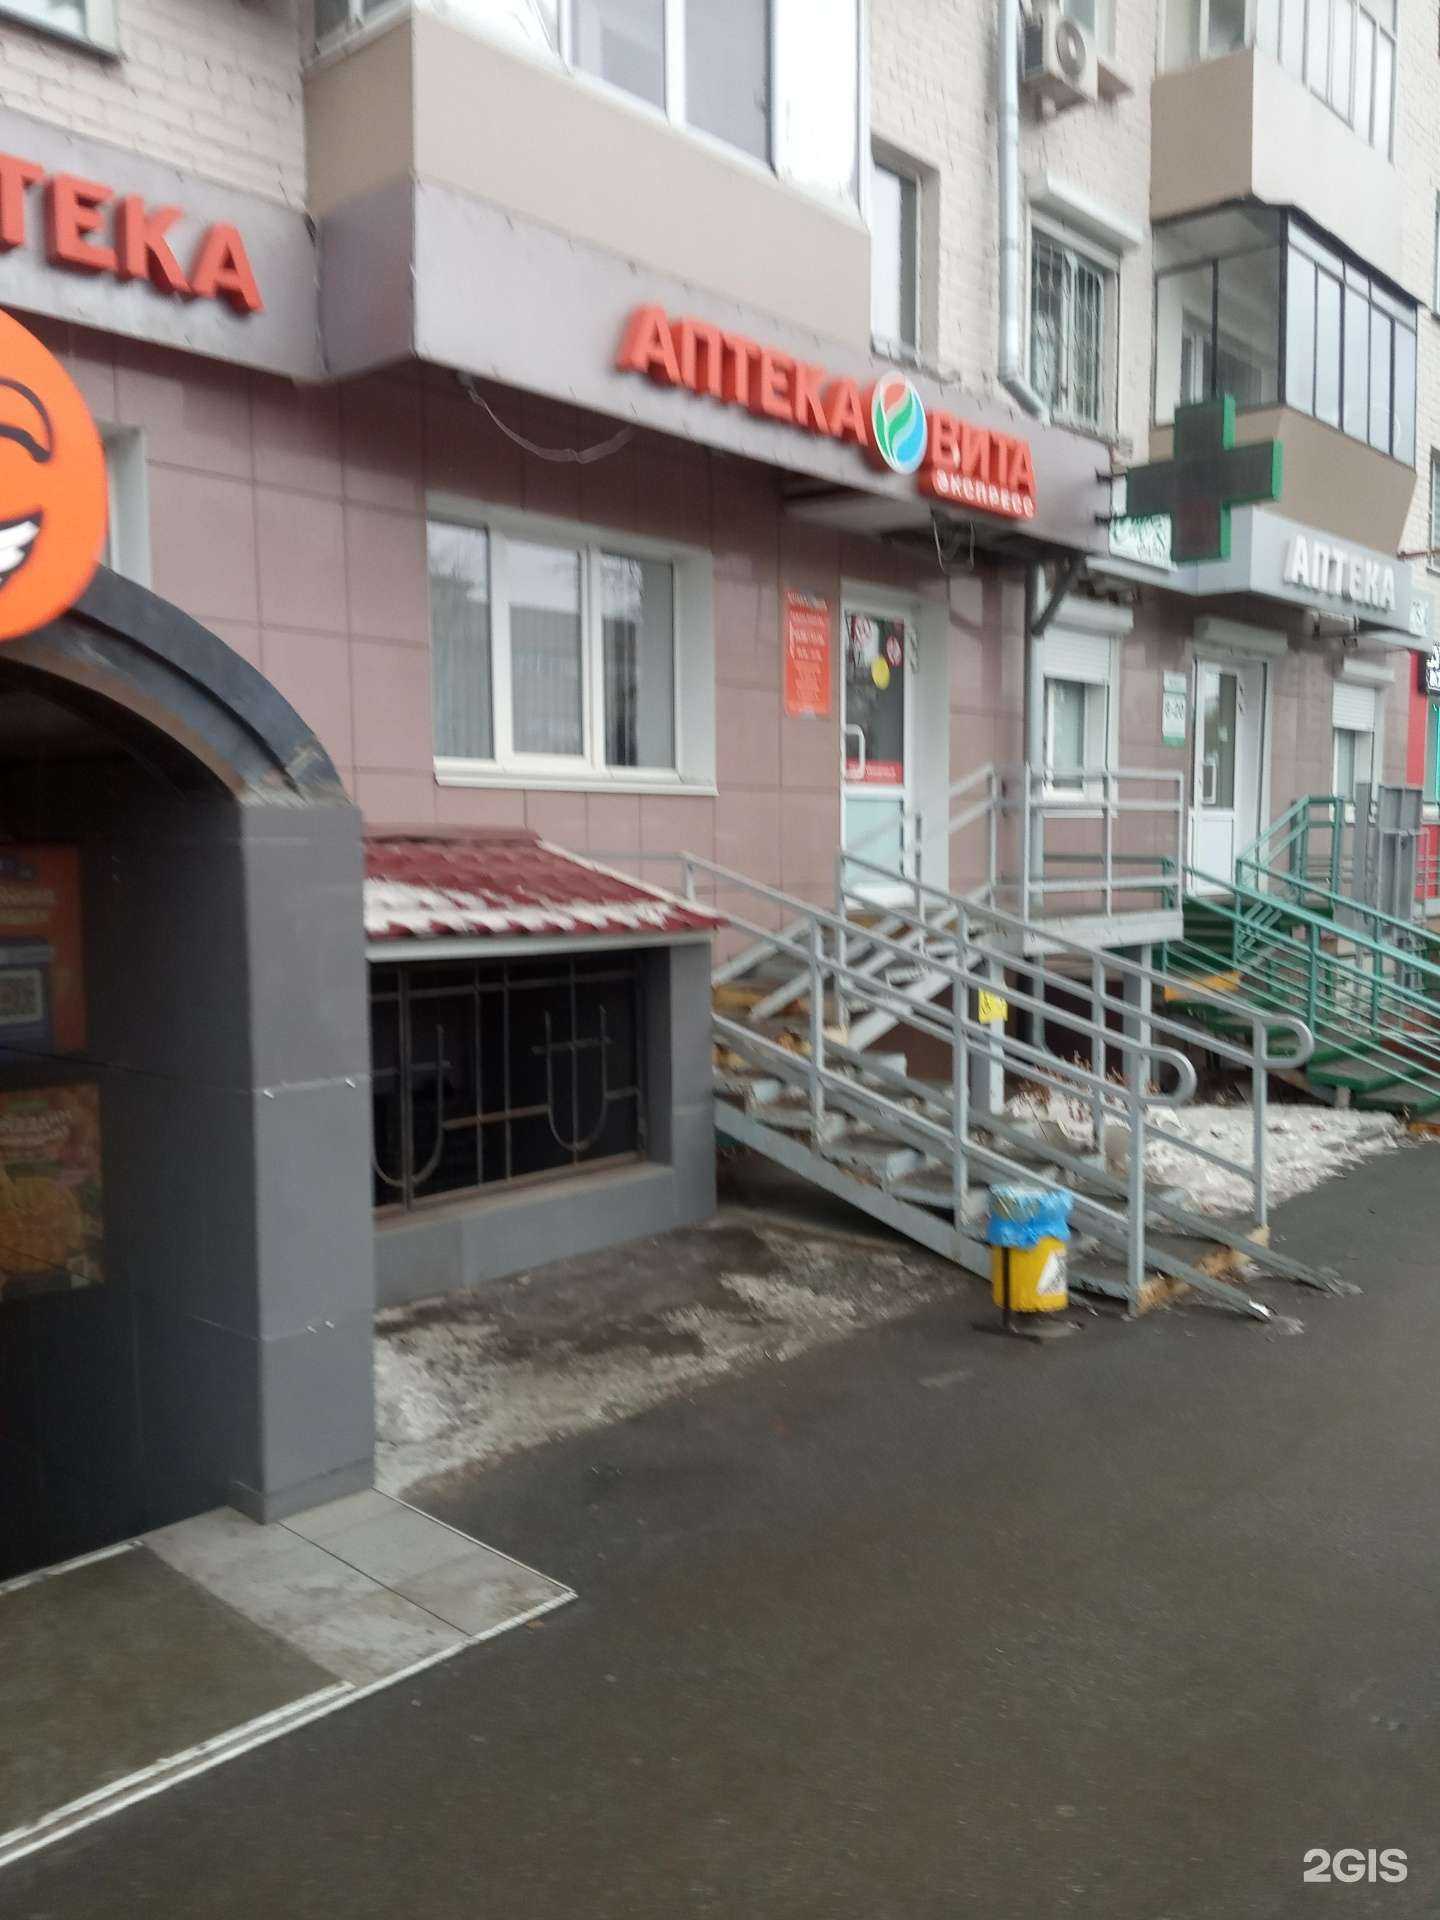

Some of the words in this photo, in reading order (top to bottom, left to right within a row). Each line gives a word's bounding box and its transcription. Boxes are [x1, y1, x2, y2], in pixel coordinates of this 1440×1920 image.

[616, 303, 869, 447] АПТЕКА
[929, 410, 1037, 498] ВИТА
[1284, 534, 1396, 611] АПТЕКА
